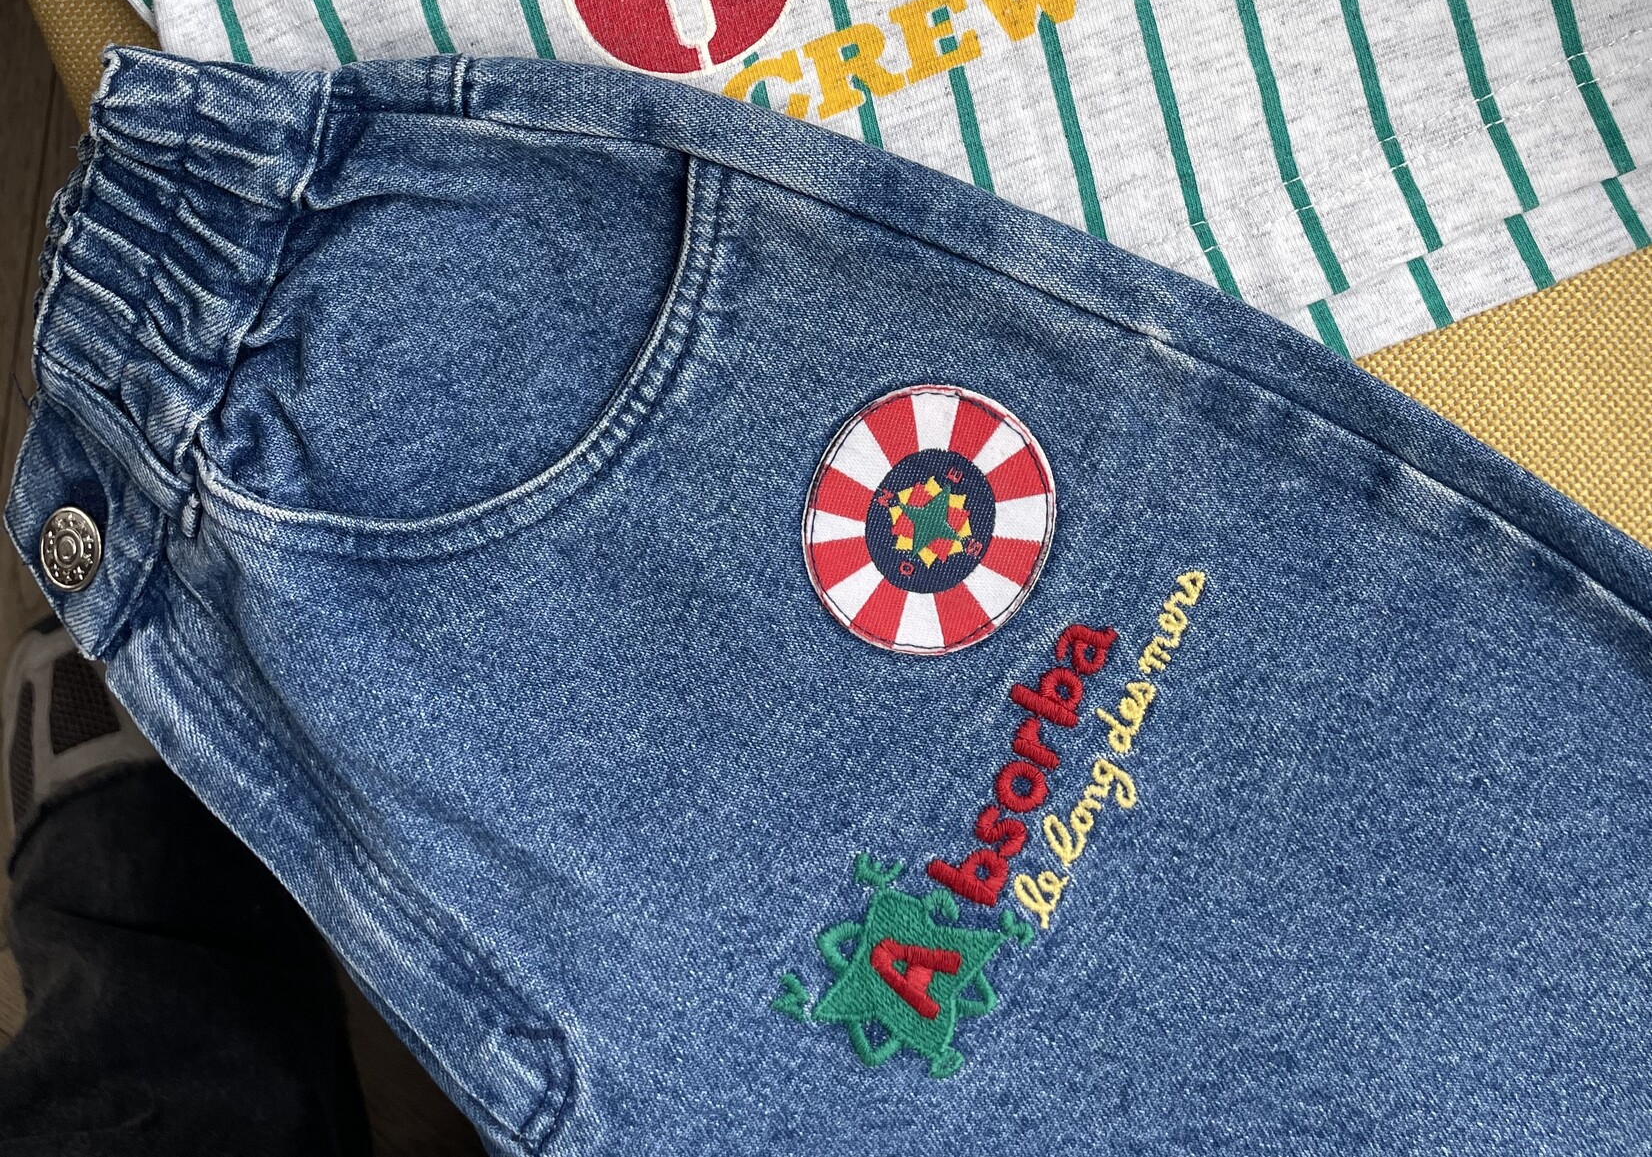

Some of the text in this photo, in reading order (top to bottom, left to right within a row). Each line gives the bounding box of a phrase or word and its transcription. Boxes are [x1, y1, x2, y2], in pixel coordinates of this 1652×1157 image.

[1014, 570, 1206, 929] le long des mers
